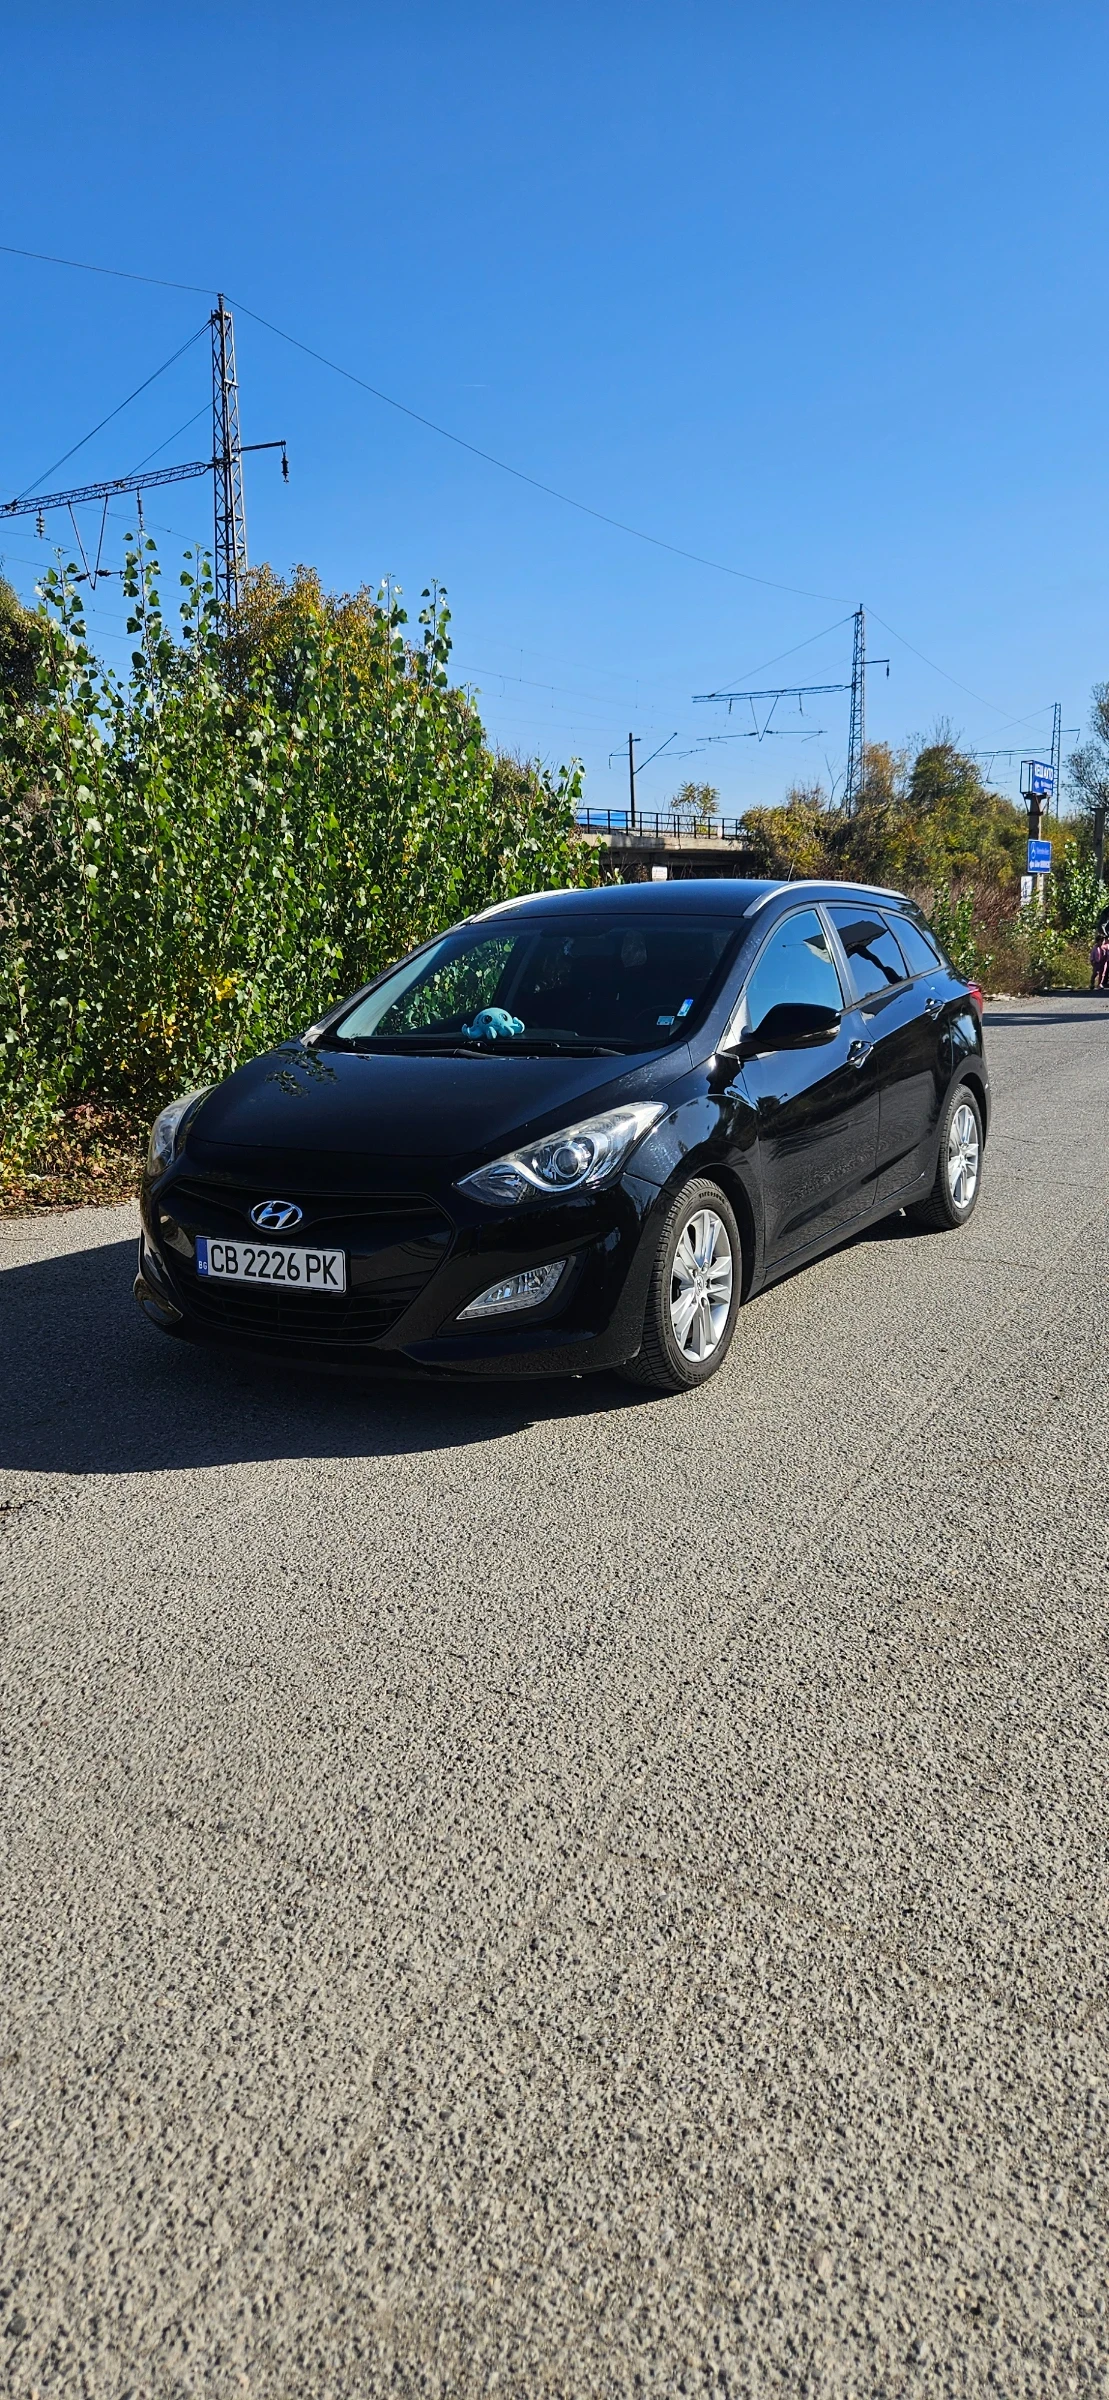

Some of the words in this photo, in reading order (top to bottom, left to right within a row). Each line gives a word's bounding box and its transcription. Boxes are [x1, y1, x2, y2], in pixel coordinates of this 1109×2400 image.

[198, 1260, 208, 1270] BG
[210, 1244, 239, 1275] CB
[243, 1248, 301, 1281] 2226
[305, 1253, 339, 1286] PK
